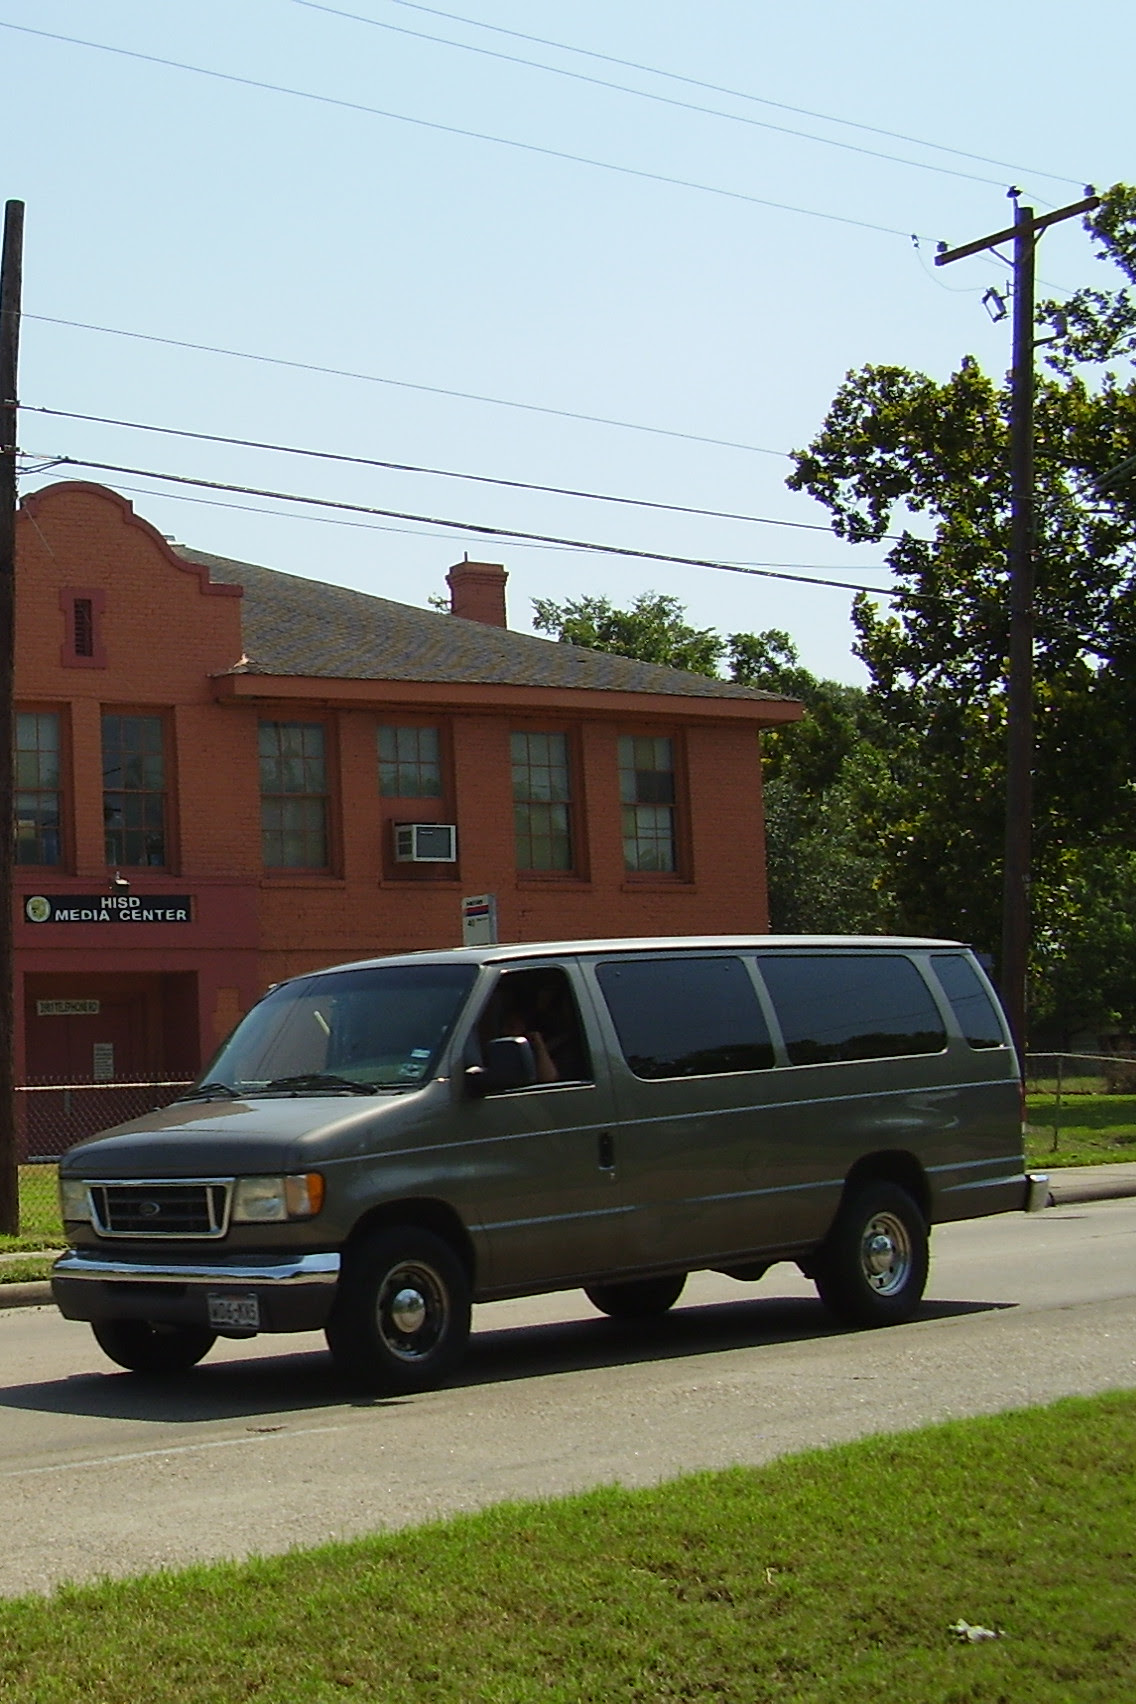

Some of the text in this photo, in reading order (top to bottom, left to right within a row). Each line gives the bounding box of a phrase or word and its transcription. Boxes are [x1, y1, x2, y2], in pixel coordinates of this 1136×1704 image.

[100, 896, 141, 909] HISD
[55, 909, 187, 921] MEDIA CENTER
